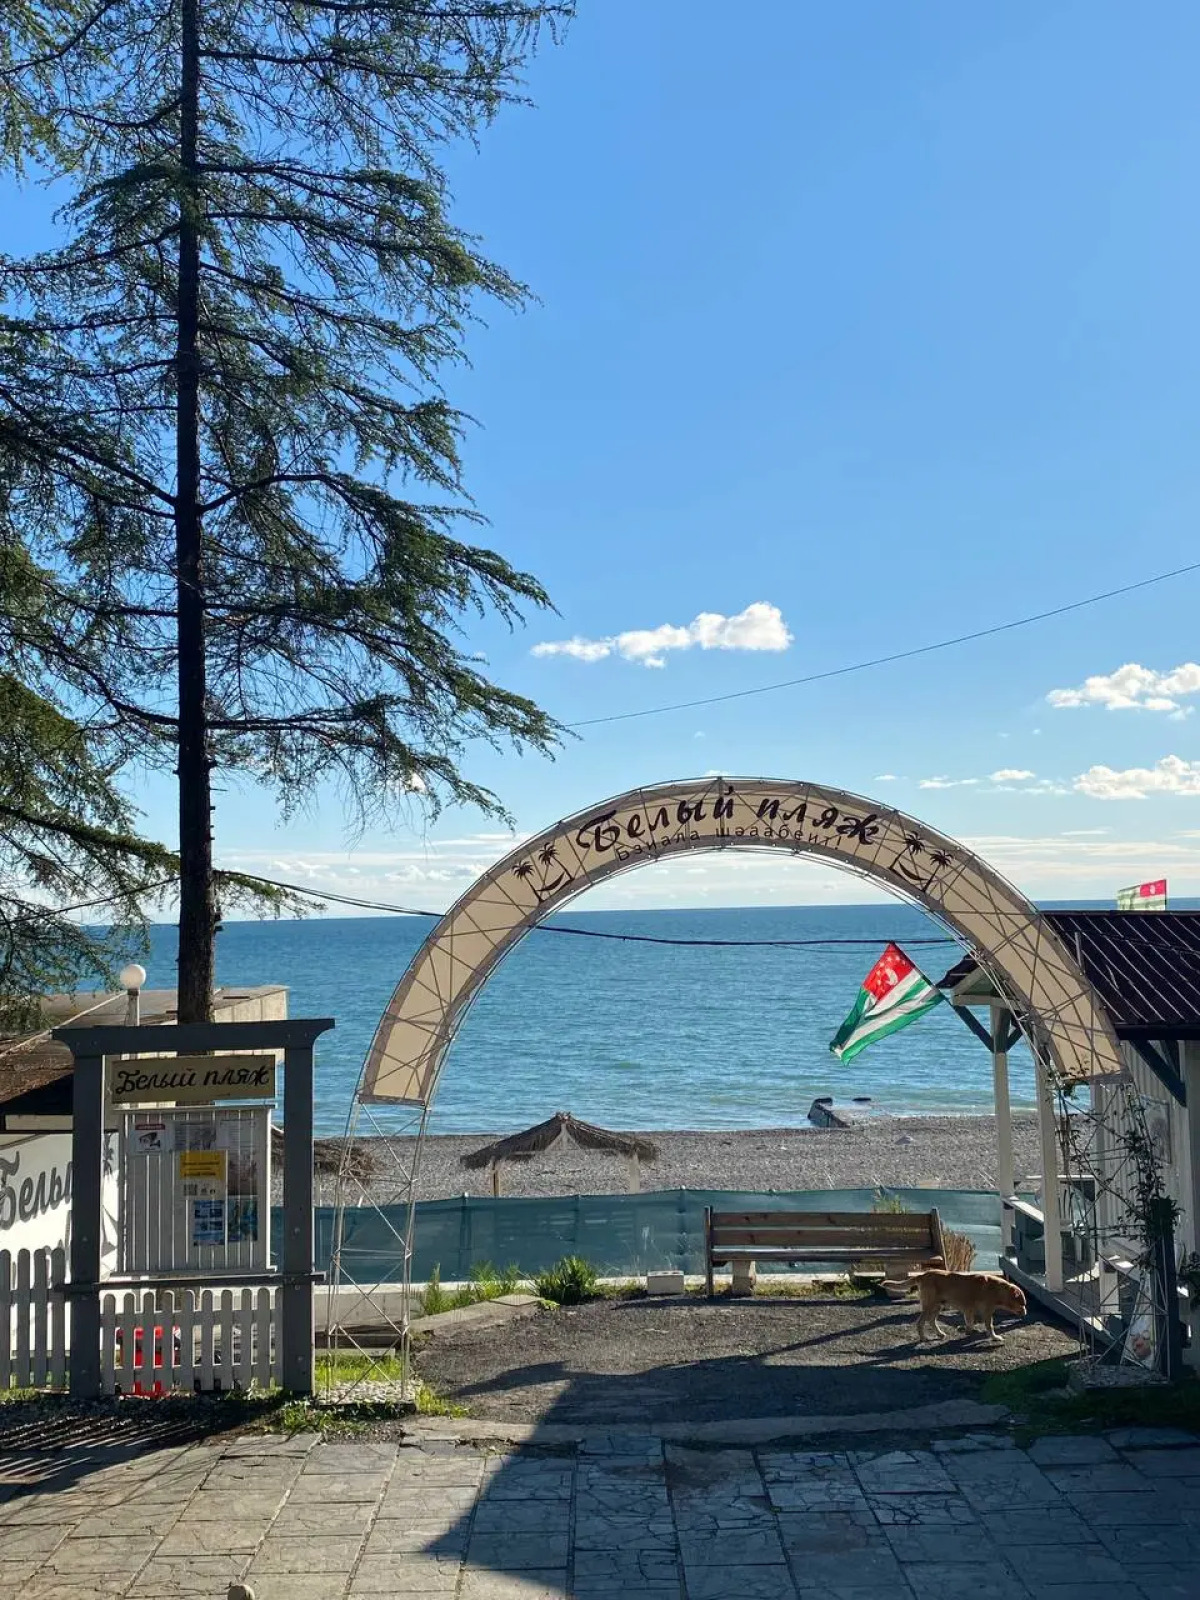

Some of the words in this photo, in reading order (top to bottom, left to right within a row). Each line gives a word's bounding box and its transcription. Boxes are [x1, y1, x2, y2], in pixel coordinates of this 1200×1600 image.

[576, 785, 735, 851] Белый
[756, 797, 880, 845] пляж
[115, 1068, 197, 1095] Белый
[202, 1065, 269, 1087] пляж
[0, 1151, 73, 1231] Белы
